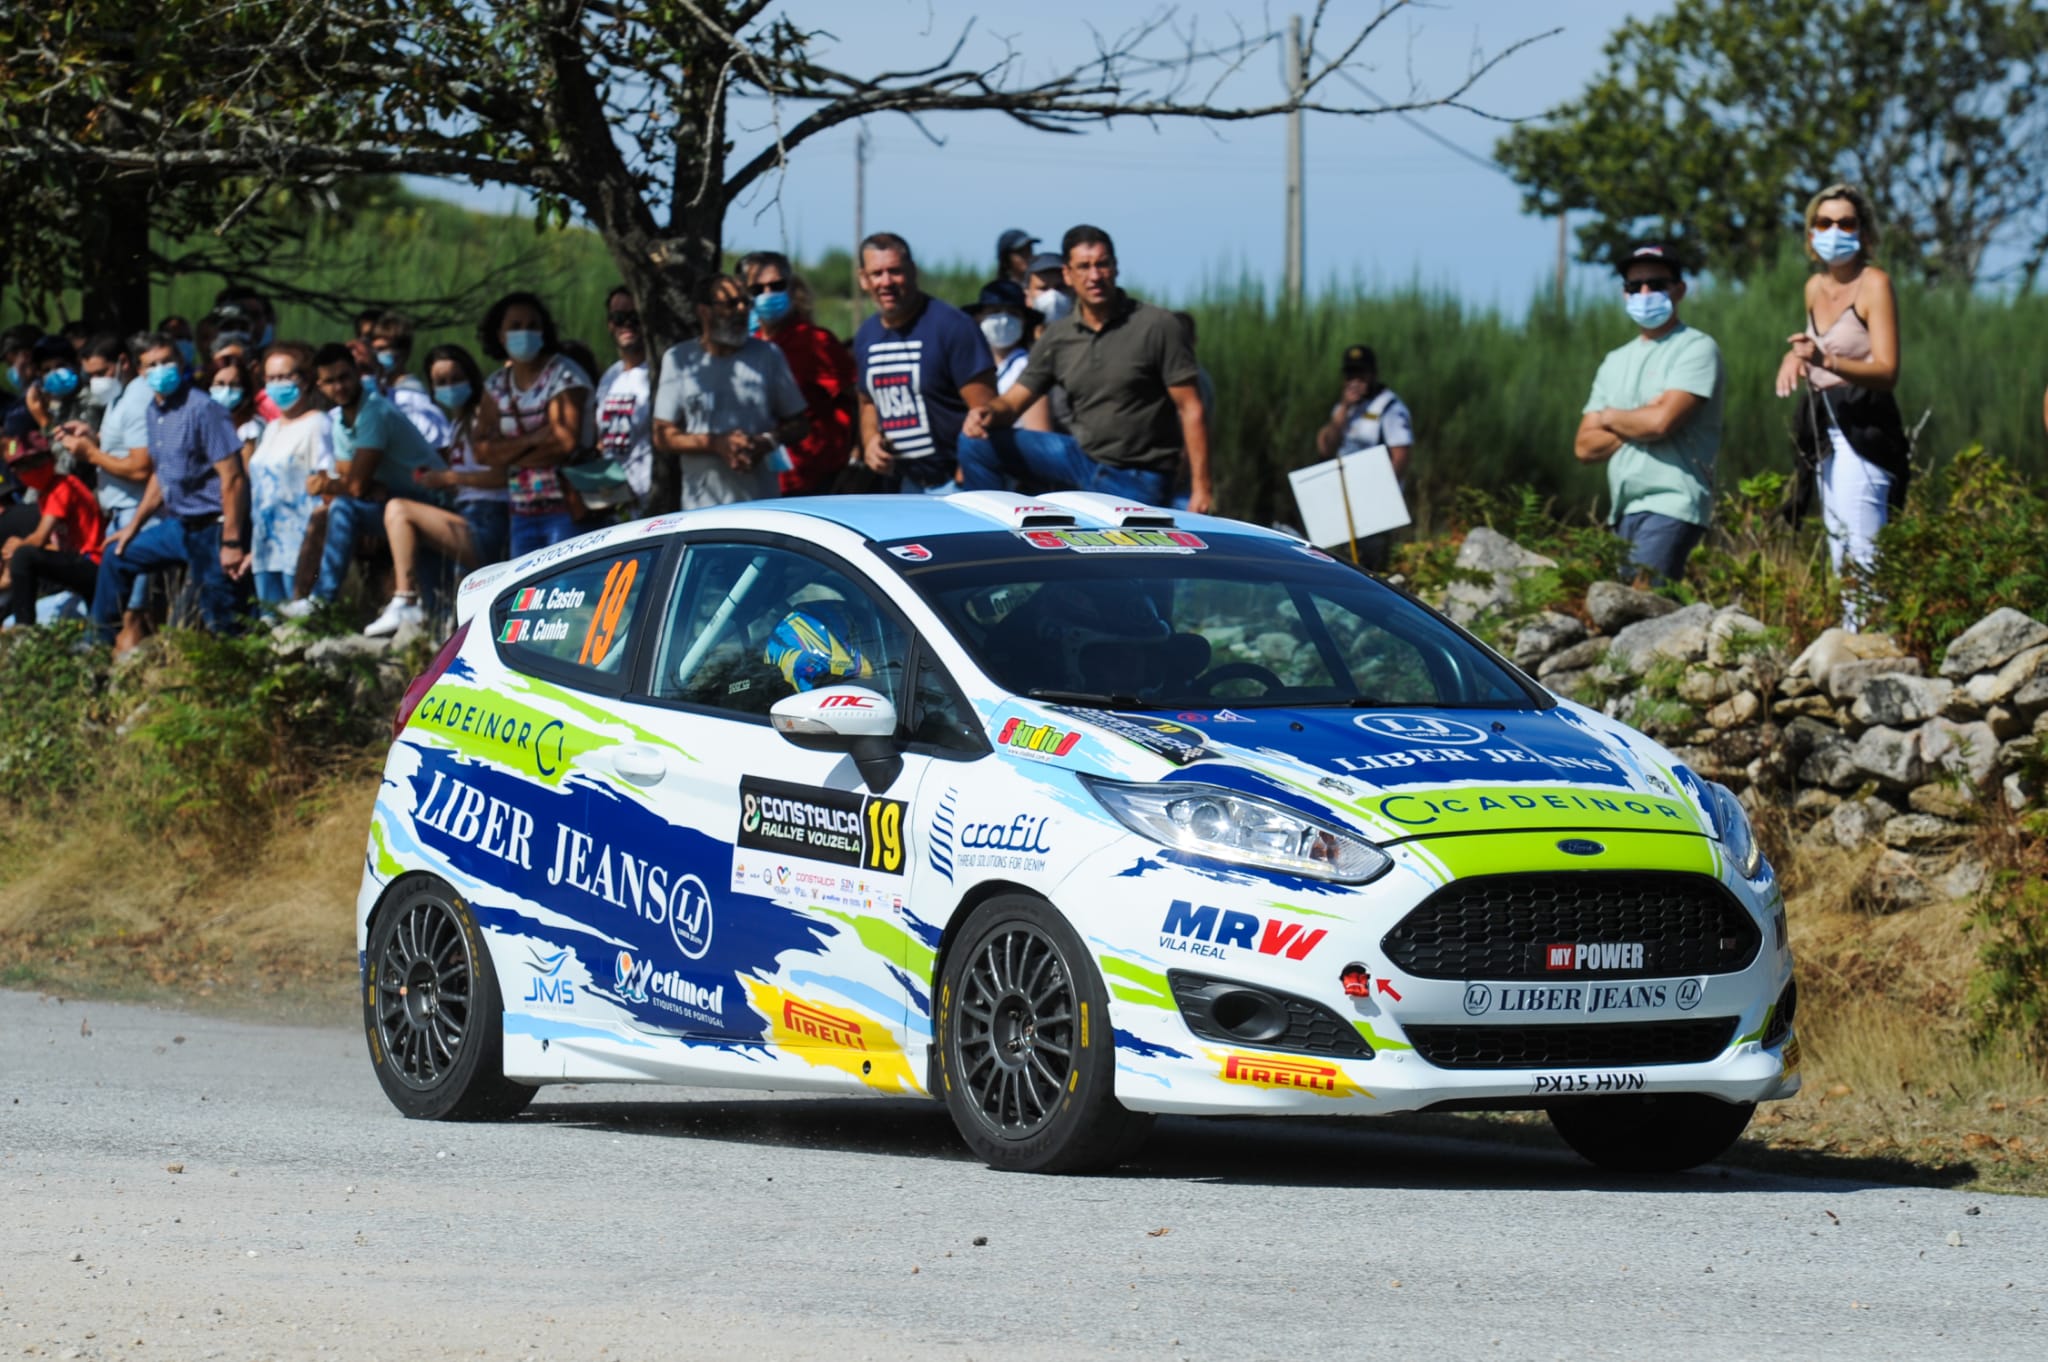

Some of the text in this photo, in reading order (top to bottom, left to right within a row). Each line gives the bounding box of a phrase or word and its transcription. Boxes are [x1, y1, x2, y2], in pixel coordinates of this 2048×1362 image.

[875, 385, 917, 418] USA
[529, 587, 585, 610] M. Castro
[578, 559, 639, 666] 19
[517, 618, 570, 641] R. Cunha
[420, 696, 532, 749] CADEINOR
[1331, 747, 1613, 773] LIBER JEANS
[1443, 794, 1682, 820] CADEINOR
[415, 770, 669, 924] LIBER JEANS
[761, 822, 861, 853] RALLYE VOUZELA
[868, 800, 901, 871] 19
[675, 888, 707, 934] LJ
[1161, 899, 1329, 961] MRW
[1159, 936, 1227, 961] VILA REAL
[1550, 943, 1645, 970] MY POWER
[524, 977, 575, 1005] JMS
[1498, 988, 1581, 1011] LIBER
[1588, 985, 1667, 1013] JEANS
[652, 997, 725, 1029] ETIQUETAS DE PORTUGAL
[783, 999, 867, 1051] PIRELLI
[1225, 1055, 1338, 1091] PIRELLI
[1534, 1073, 1645, 1093] PX15 HVN
